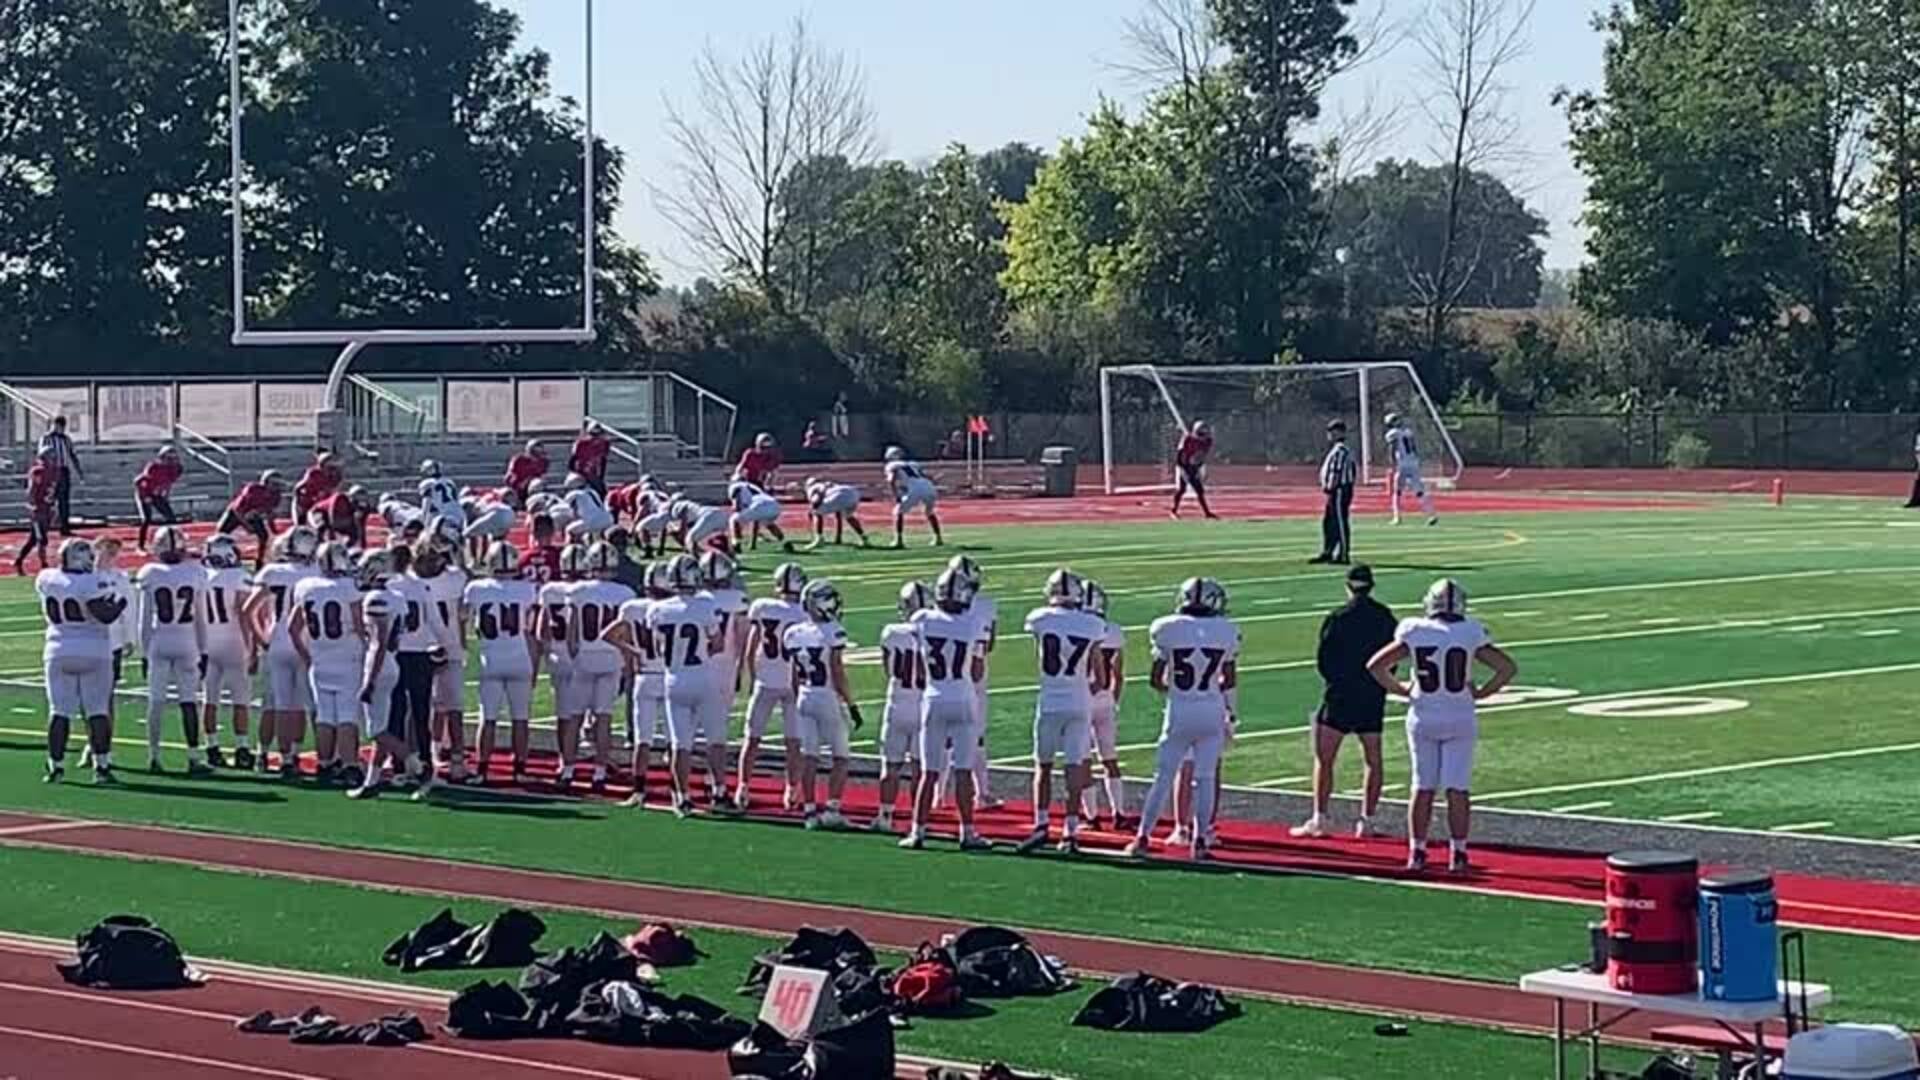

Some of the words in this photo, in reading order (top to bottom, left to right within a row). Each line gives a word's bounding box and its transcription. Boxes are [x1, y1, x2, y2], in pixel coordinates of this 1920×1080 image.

[657, 622, 702, 667] 72
[925, 635, 968, 681] 31
[1042, 633, 1091, 677] 87
[1173, 647, 1225, 692] 57
[1415, 646, 1469, 693] 50
[772, 978, 815, 1028] 40
